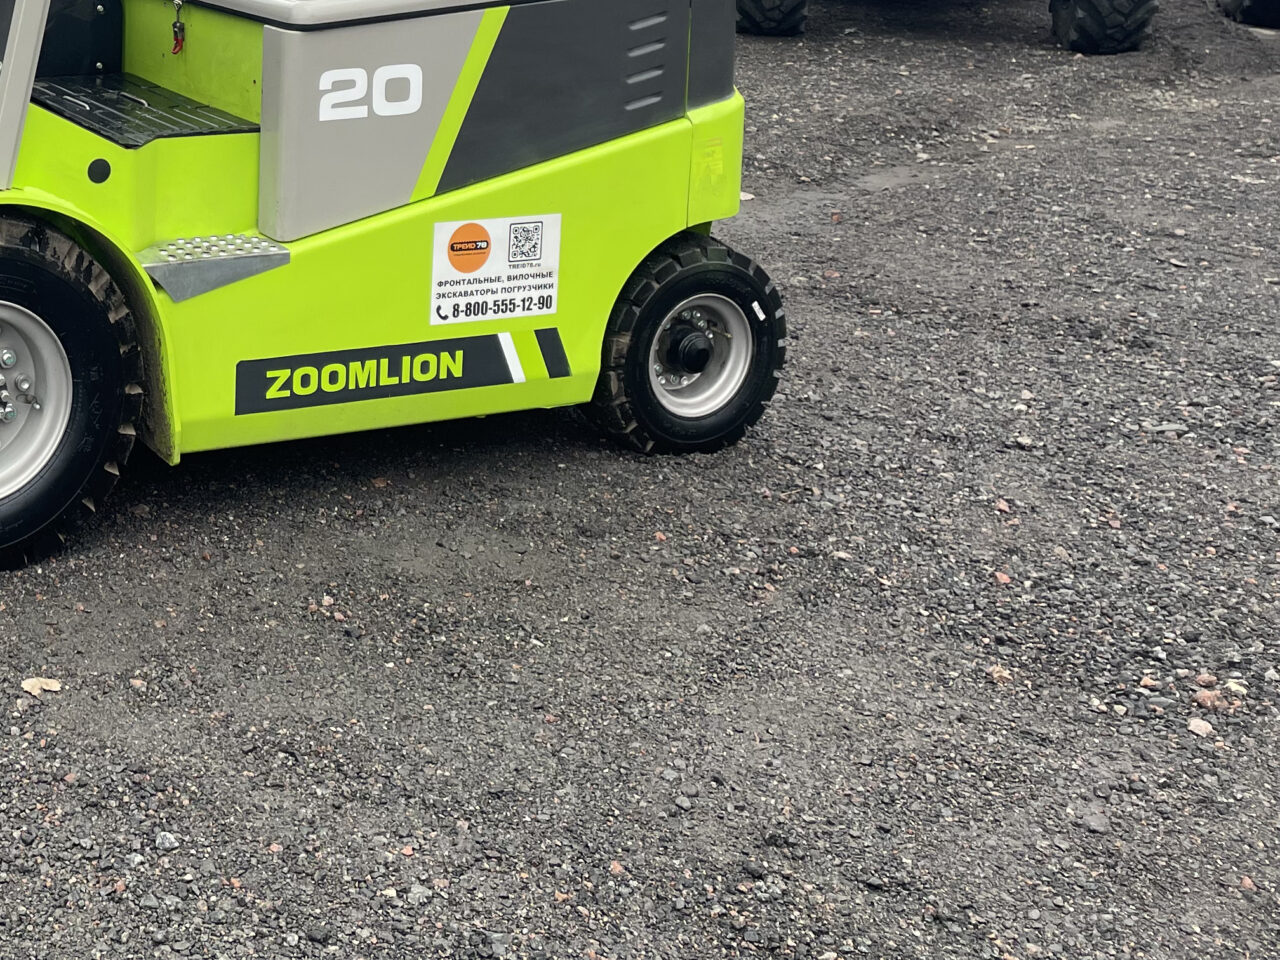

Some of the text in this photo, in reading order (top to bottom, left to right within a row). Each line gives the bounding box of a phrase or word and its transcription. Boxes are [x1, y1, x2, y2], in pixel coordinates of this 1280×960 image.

[319, 63, 423, 121] 20
[436, 283, 554, 300] ЭКСКАВАТОРЫ ПОГРУЗЧИКИ
[437, 271, 553, 288] ФРОНТАЛЬНЫЕ, ВИЛОЧНЫЕ
[452, 294, 553, 319] 8-800-555-12-90
[266, 350, 463, 399] ZOOMLION
